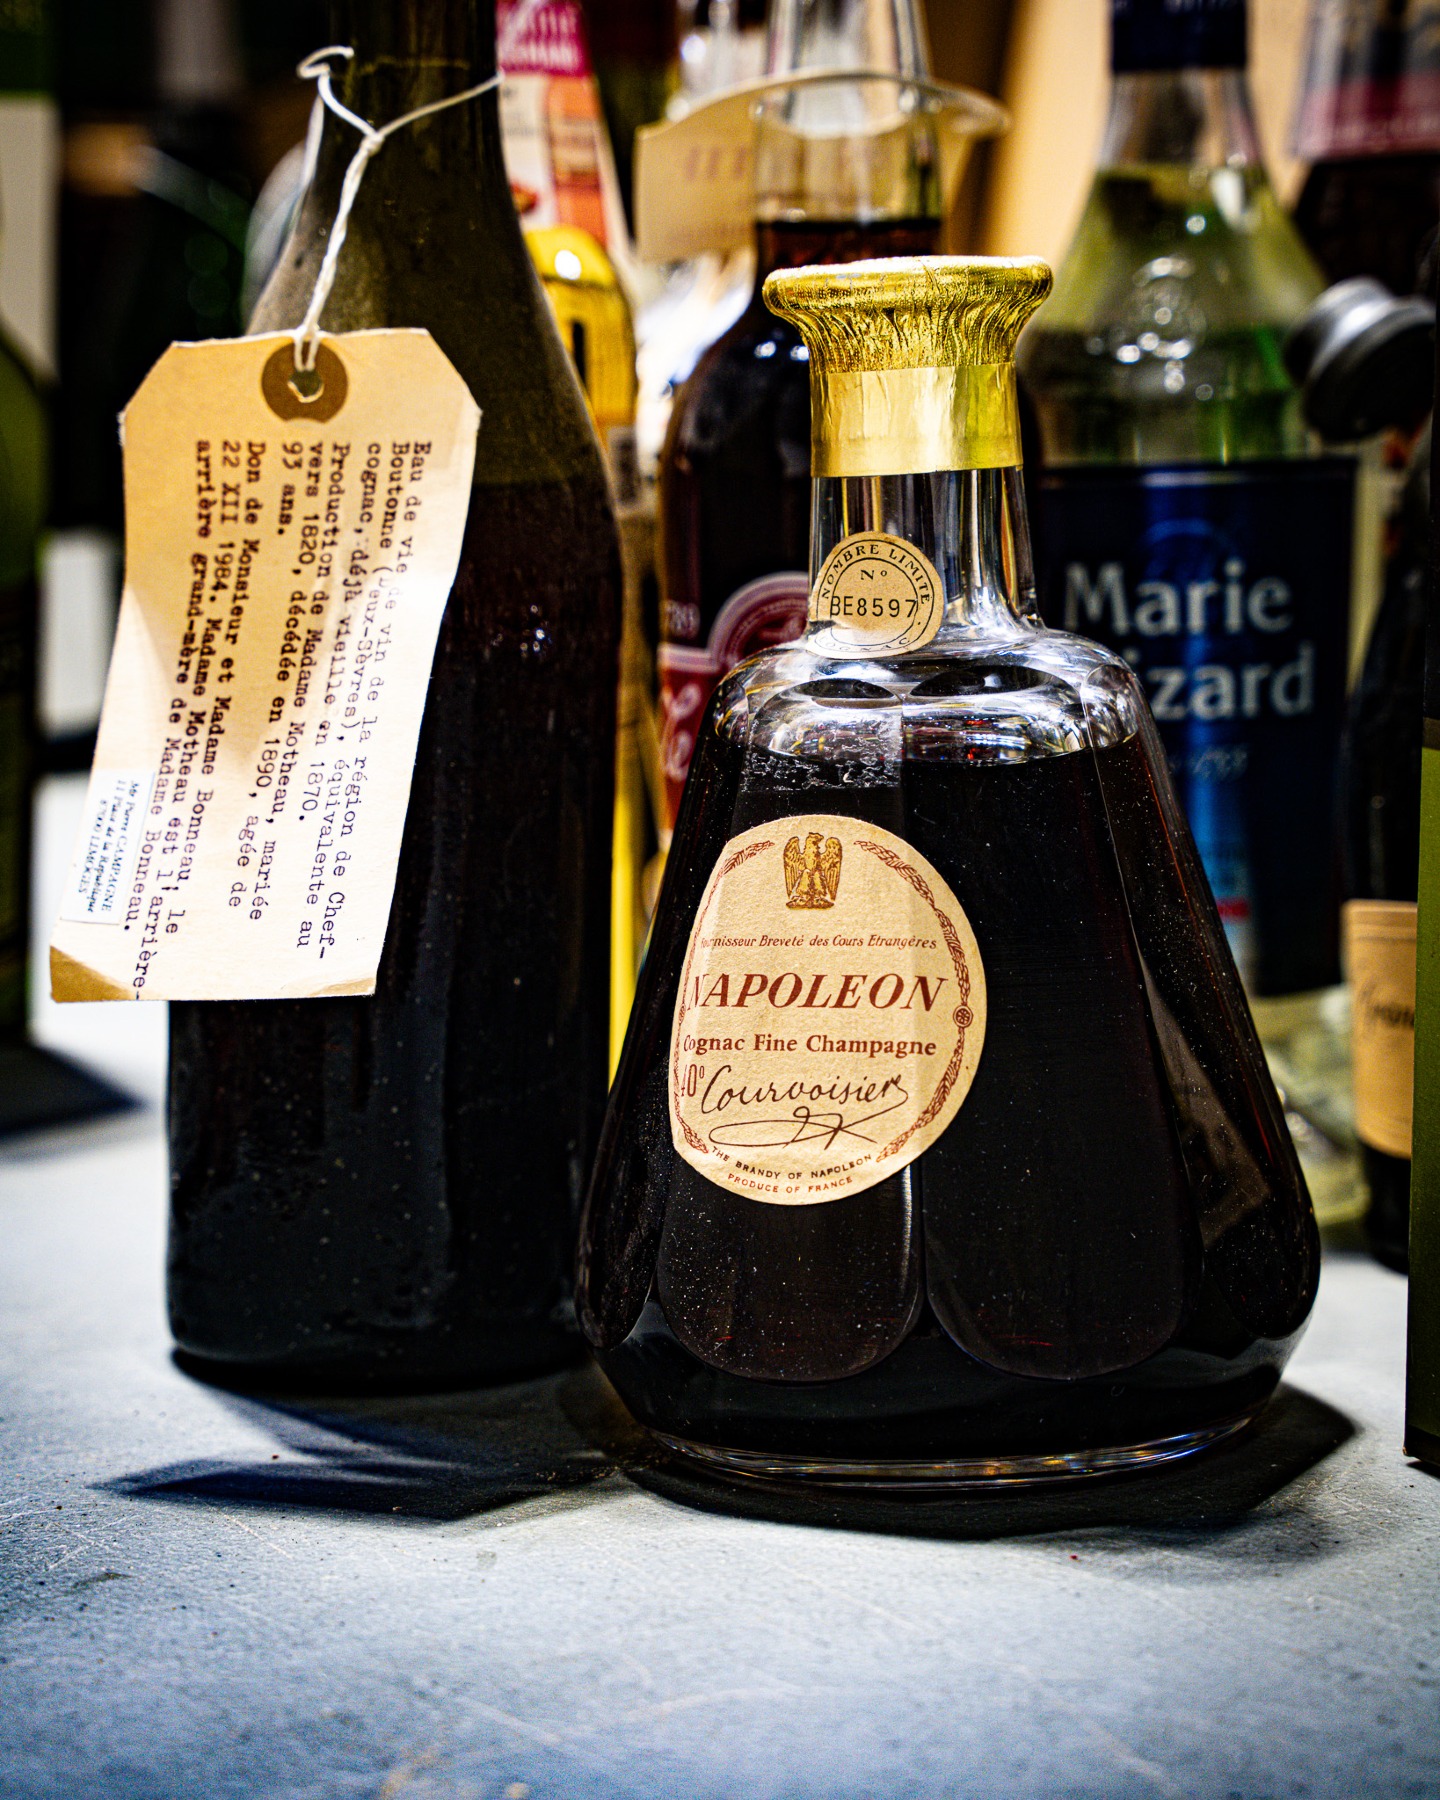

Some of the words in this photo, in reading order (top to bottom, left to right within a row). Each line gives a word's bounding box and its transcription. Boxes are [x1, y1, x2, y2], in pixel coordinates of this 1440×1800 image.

[223, 440, 241, 468] 22
[247, 441, 266, 483] Don
[282, 441, 303, 470] 93
[306, 442, 323, 497] vers
[410, 441, 431, 482] Eau
[197, 440, 216, 539] arrière
[220, 483, 240, 525] XII
[245, 498, 263, 525] de
[277, 484, 297, 535] ans.
[318, 442, 351, 578] Production
[354, 442, 382, 534] cognac,
[380, 442, 410, 549] Boutonne
[404, 496, 421, 522] de
[292, 514, 320, 575] 1820,
[396, 536, 414, 573] vie
[209, 541, 236, 602] 1984.
[225, 538, 260, 645] Monsieur
[343, 550, 369, 602] déjà
[822, 544, 880, 600] NOMBRE
[1064, 557, 1294, 636] Marie
[176, 553, 209, 685] grand-mère
[311, 590, 329, 615] de
[384, 587, 403, 610] de
[831, 595, 918, 618] BE8597
[193, 618, 223, 697] Madame
[277, 590, 307, 681] décédée
[324, 615, 352, 705] vieille
[374, 624, 392, 663] vin
[218, 658, 236, 683] et
[294, 629, 323, 707] Madame
[367, 676, 384, 701] de
[1122, 641, 1315, 721] zard
[169, 698, 188, 724] de
[201, 696, 231, 775] Madame
[269, 697, 286, 723] en
[314, 721, 330, 746] en
[359, 716, 378, 743] la
[150, 738, 180, 816] Madame
[172, 710, 206, 803] Motheau
[248, 738, 280, 798] 1890,
[265, 721, 306, 824] Motheau,
[299, 762, 326, 820] 1870.
[340, 757, 368, 838] région
[102, 842, 112, 851] la
[106, 827, 115, 837] de
[172, 789, 214, 890] Bonneau,
[238, 816, 260, 867] agée
[307, 760, 350, 905] équivalente
[79, 836, 100, 893] LIMOGES
[101, 836, 128, 912] CAMPAGNE
[124, 830, 161, 932] Bonneau.
[249, 840, 276, 920] mariée
[333, 851, 351, 877] de
[228, 882, 246, 907] de
[165, 910, 185, 934] le
[297, 920, 313, 948] au
[319, 891, 345, 959] Chef-
[758, 934, 803, 948] Breveté
[809, 934, 829, 948] des
[832, 934, 864, 948] Cours
[868, 934, 937, 950] Etrangères
[687, 972, 949, 1012] NAPOLEON
[683, 1034, 745, 1057] Cognac
[754, 1033, 798, 1052] Fine
[806, 1034, 937, 1059] Champagne
[712, 1146, 730, 1162] THE
[735, 1160, 781, 1180] BRANDY
[788, 1172, 803, 1180] OF
[811, 1154, 872, 1179] NAPOLEON
[728, 1173, 778, 1193] PRODUCE
[786, 1185, 801, 1194] OF
[808, 1176, 853, 1193] FRANCE
